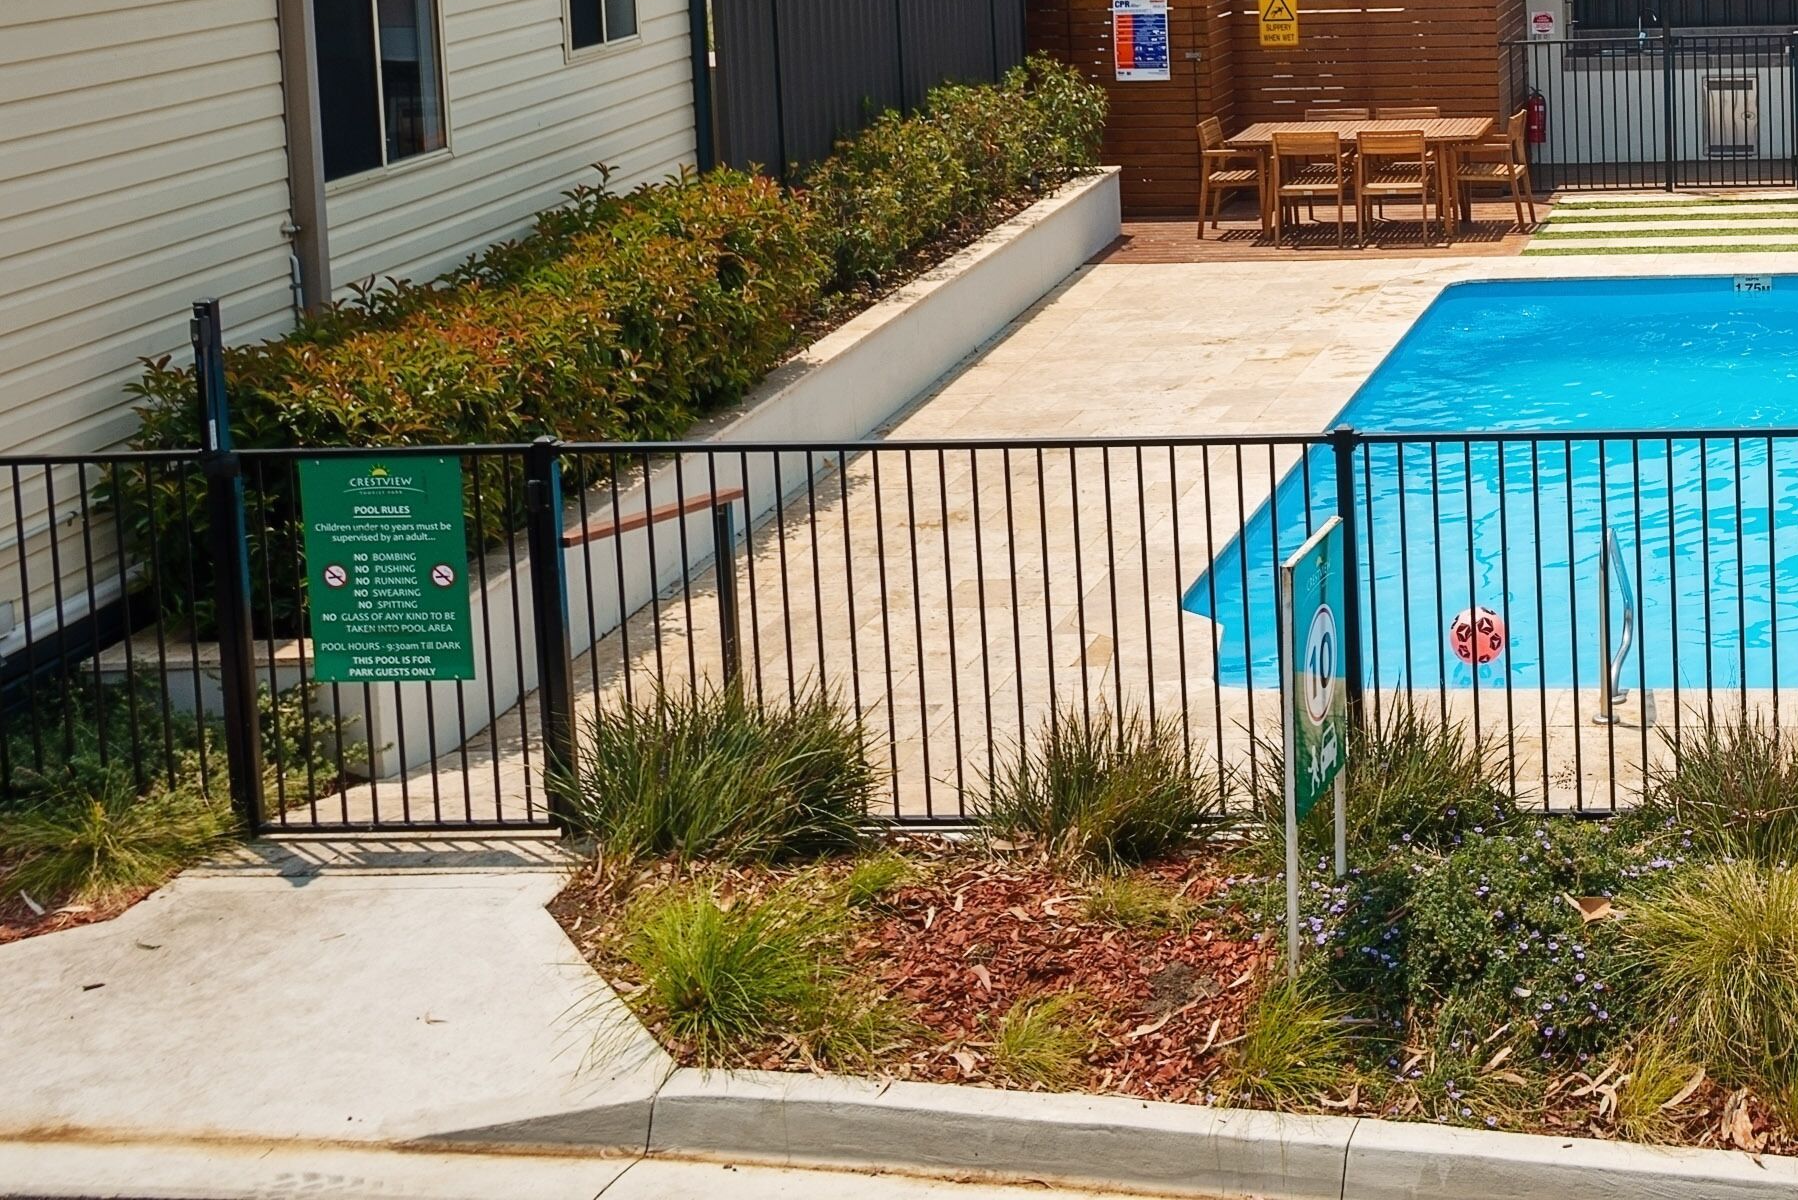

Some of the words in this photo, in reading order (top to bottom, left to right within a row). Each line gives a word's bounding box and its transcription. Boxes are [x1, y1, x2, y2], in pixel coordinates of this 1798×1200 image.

[1115, 0, 1130, 8] CPR
[1265, 23, 1291, 31] SLIPPERY
[1282, 33, 1294, 41] WET
[349, 477, 412, 487] CRESTVIEW
[354, 506, 380, 514] POOL
[315, 523, 351, 531] Children
[352, 522, 378, 531] under
[391, 523, 415, 532] years
[440, 521, 452, 530] be
[332, 533, 379, 543] supervised
[380, 533, 391, 543] by
[405, 532, 436, 541] adult...
[353, 553, 368, 561] NO
[372, 552, 417, 561] BOMBING
[354, 565, 370, 573] NO
[374, 564, 416, 573] PUSHING
[355, 577, 370, 585] NO
[374, 576, 418, 585] RUNNING
[353, 589, 369, 597] NO
[372, 588, 421, 597] SWEARING
[358, 601, 373, 609] NO
[377, 600, 418, 609] SPITTING
[322, 613, 337, 621] NO
[341, 612, 370, 621] GLASS
[370, 612, 383, 621] OF
[385, 612, 404, 620] ANY
[405, 612, 429, 620] KIND
[430, 612, 443, 620] TO
[444, 612, 456, 620] BE
[346, 624, 376, 633] TAKEN
[377, 624, 400, 633] INTO
[401, 624, 427, 632] POOL
[428, 623, 453, 632] AREA
[321, 642, 347, 651] POOL
[347, 642, 381, 650] HOURS
[386, 643, 420, 652] 9:30am
[420, 641, 434, 650] Till
[435, 641, 461, 650] DARK
[352, 656, 374, 665] THIS
[375, 656, 401, 665] POOL
[401, 656, 411, 664] IS
[412, 655, 432, 664] FOR
[1309, 631, 1333, 700] 10
[349, 668, 375, 677] PARK
[375, 667, 411, 676] GUESTS
[411, 667, 436, 676] ONLY
